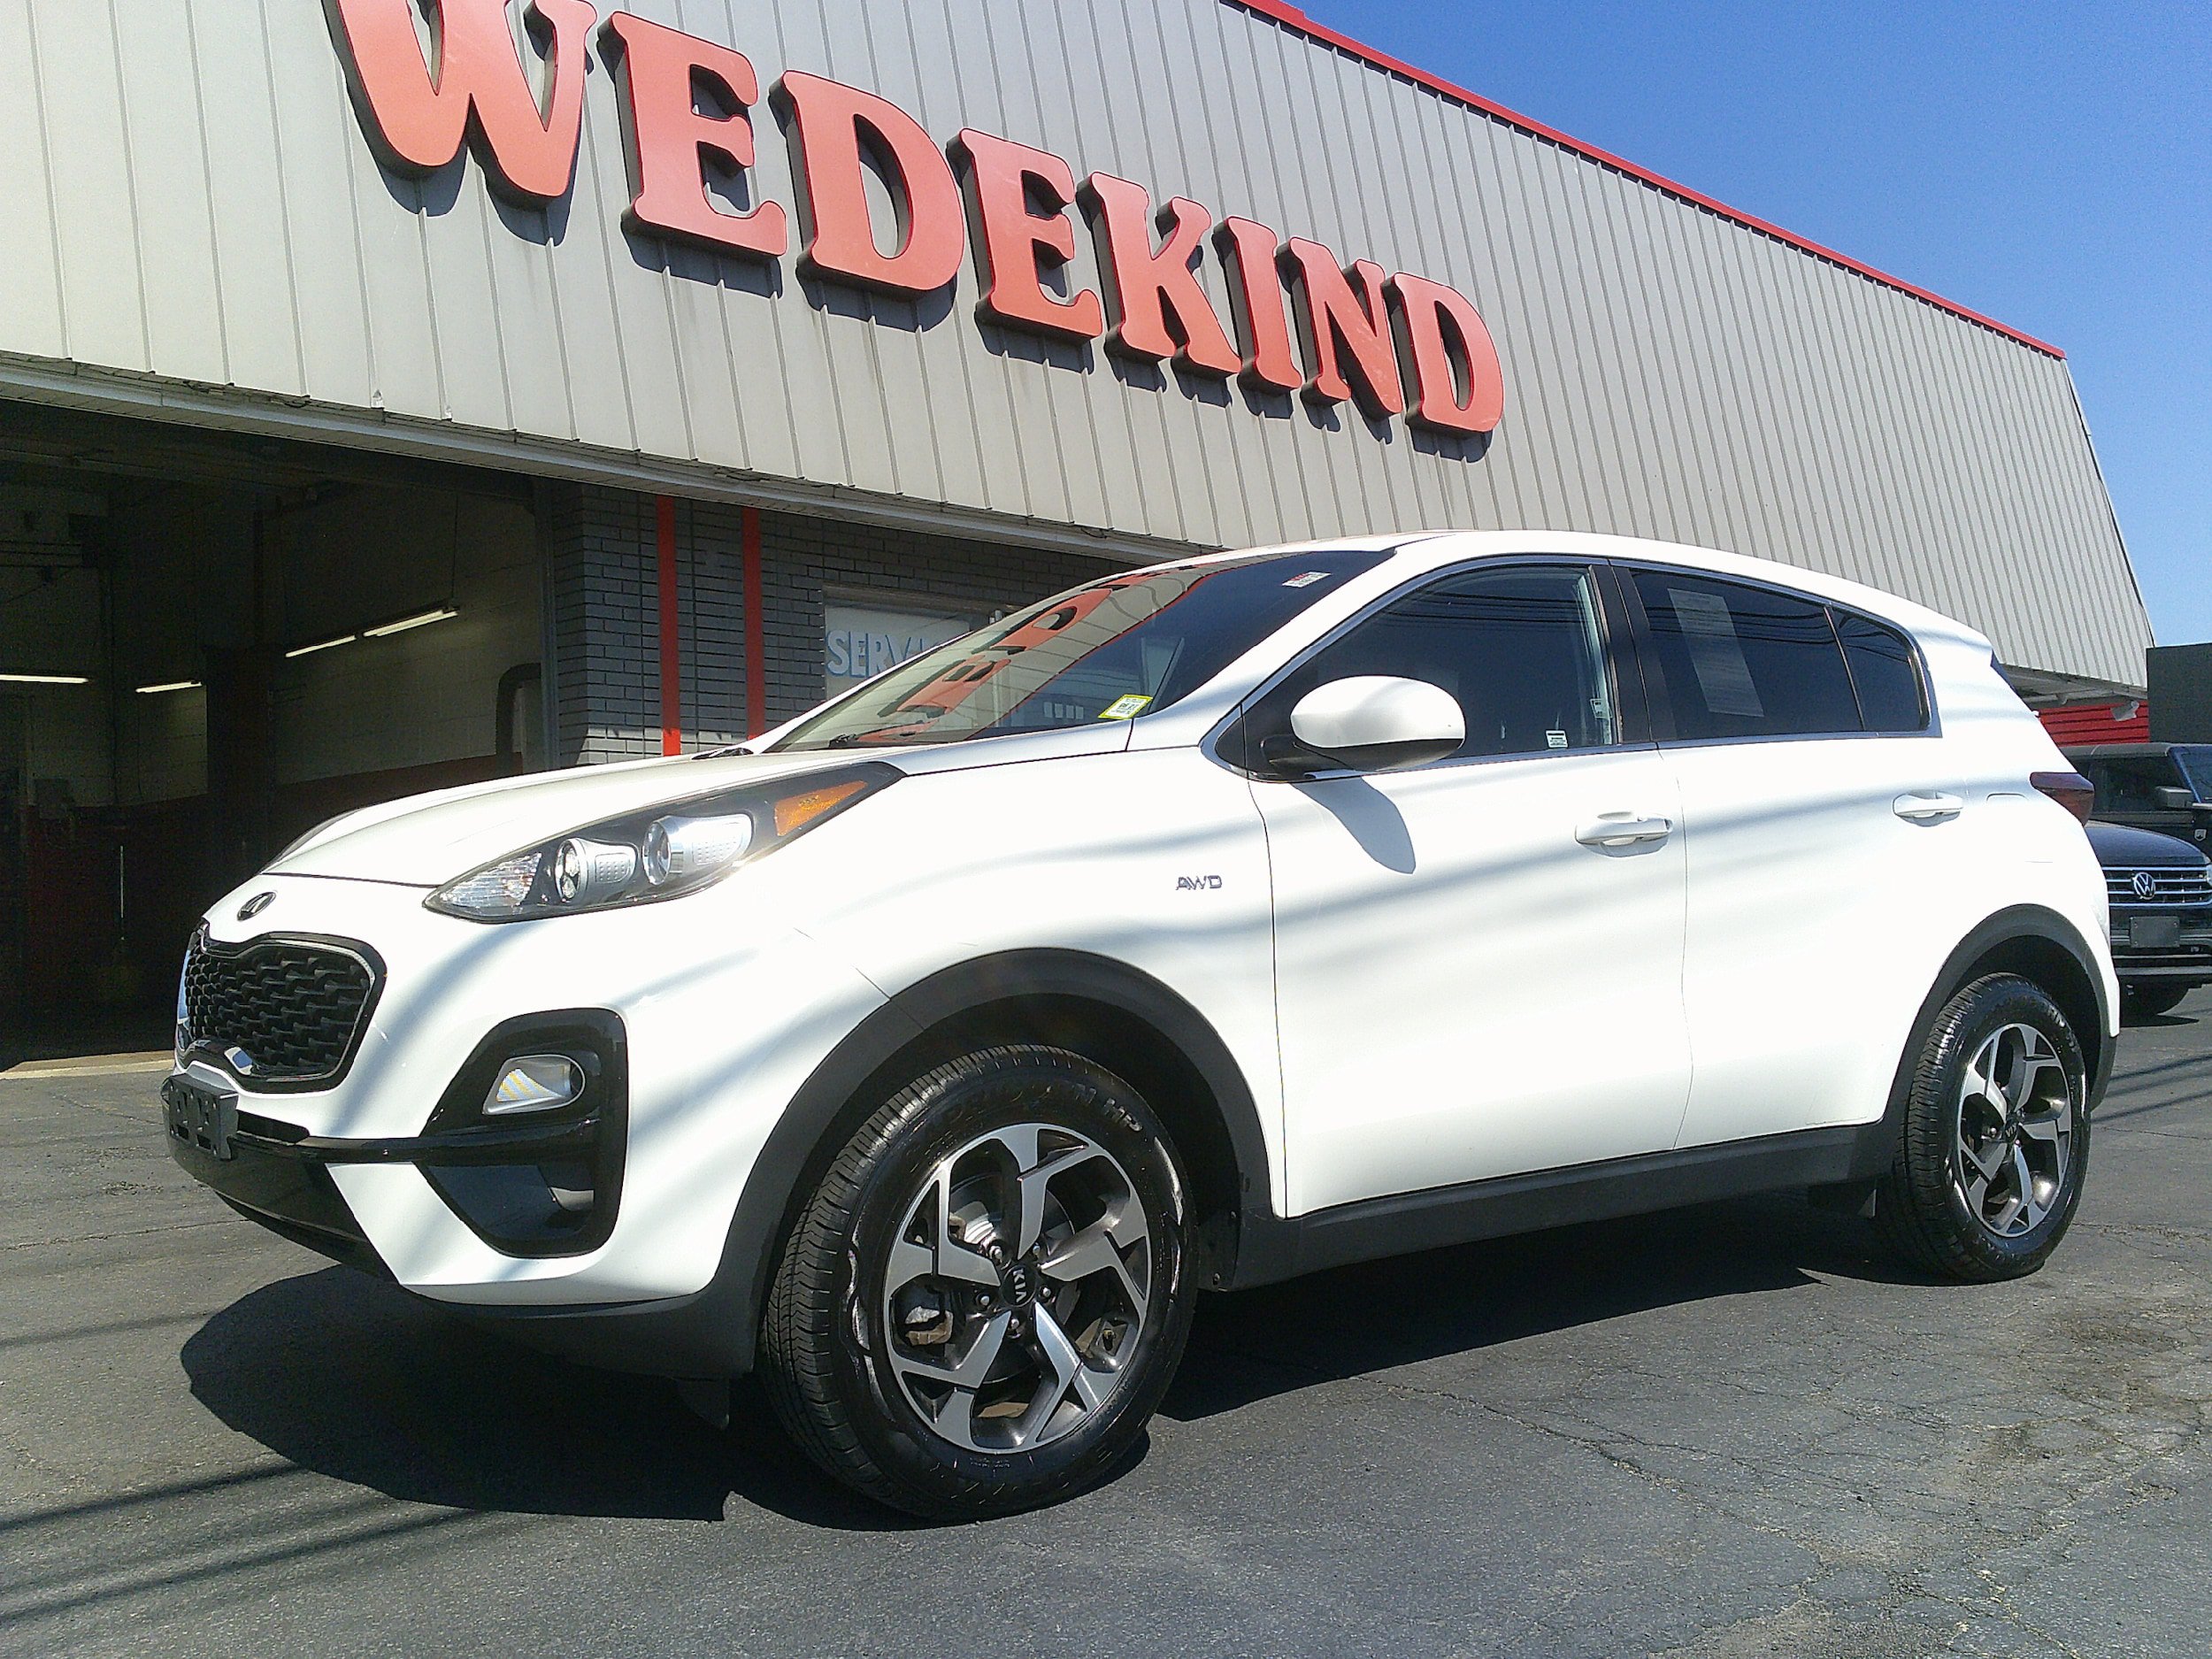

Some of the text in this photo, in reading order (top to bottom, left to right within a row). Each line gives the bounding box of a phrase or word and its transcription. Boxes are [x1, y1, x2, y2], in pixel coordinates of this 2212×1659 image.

[333, 0, 1504, 433] WEDEKIND
[826, 629, 938, 679] SERV
[1175, 874, 1222, 890] AWD
[1012, 1268, 1027, 1303] KIA
